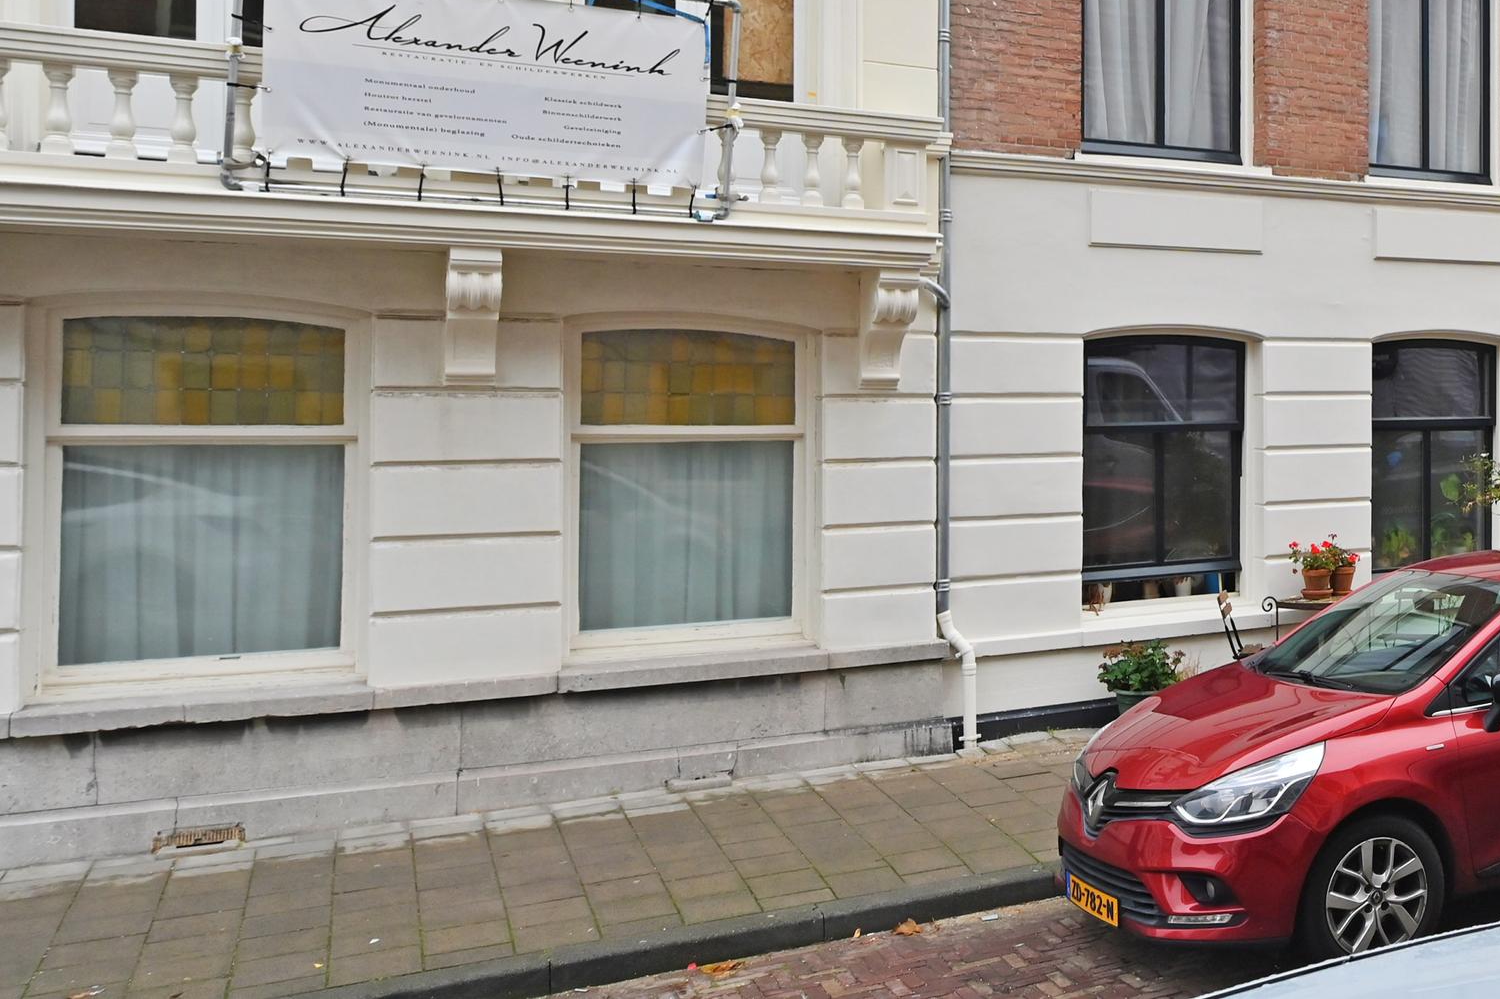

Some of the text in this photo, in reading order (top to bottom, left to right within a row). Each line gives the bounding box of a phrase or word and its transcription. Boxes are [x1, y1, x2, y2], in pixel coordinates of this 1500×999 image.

[299, 4, 681, 76] Alexander Weenink
[364, 77, 476, 94] Monumentaal onderhoud
[364, 106, 414, 115] Restauratie
[440, 127, 486, 138] beglazing
[511, 133, 535, 141] Oude
[501, 156, 679, 174] INFO@ALEXANDERWEENINKNL
[1071, 879, 1114, 922] ZD-782-N
